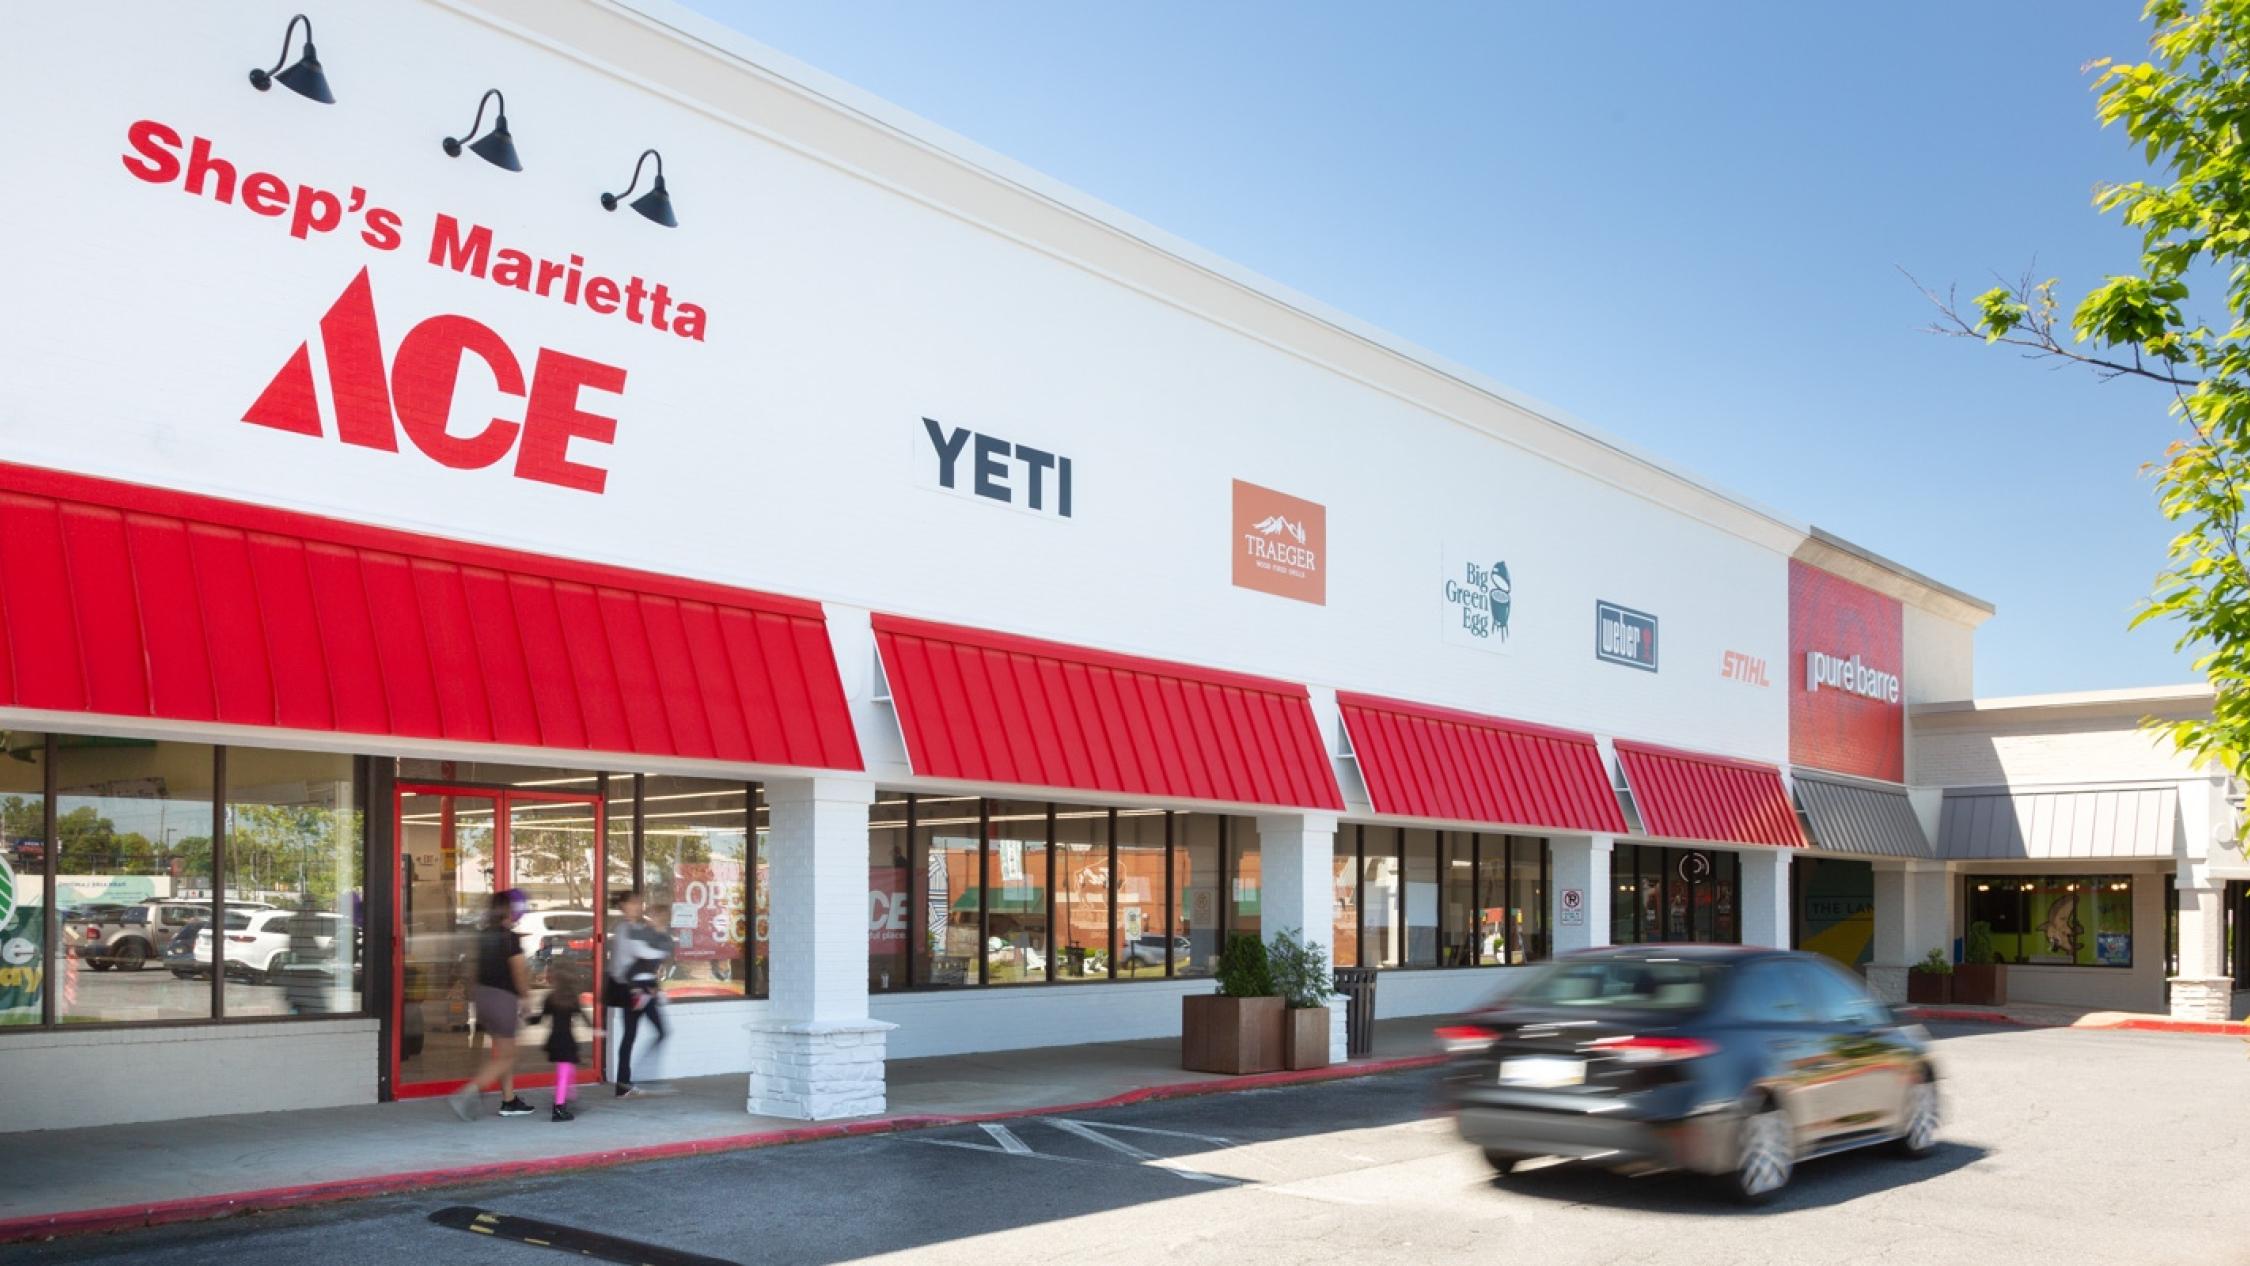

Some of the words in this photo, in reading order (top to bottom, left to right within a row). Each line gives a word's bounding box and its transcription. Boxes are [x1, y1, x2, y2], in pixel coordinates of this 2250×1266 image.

[122, 120, 403, 250] Shep's
[428, 214, 707, 342] Marietta
[241, 265, 628, 495] ACE
[922, 417, 1072, 518] YETI
[1244, 534, 1316, 571] TRAEGER
[1446, 579, 1488, 611] Green
[1467, 561, 1488, 593] Big
[1464, 607, 1488, 638] Egg
[1602, 612, 1641, 659] weber
[1721, 650, 1770, 687] STIHL
[869, 889, 908, 929] CE
